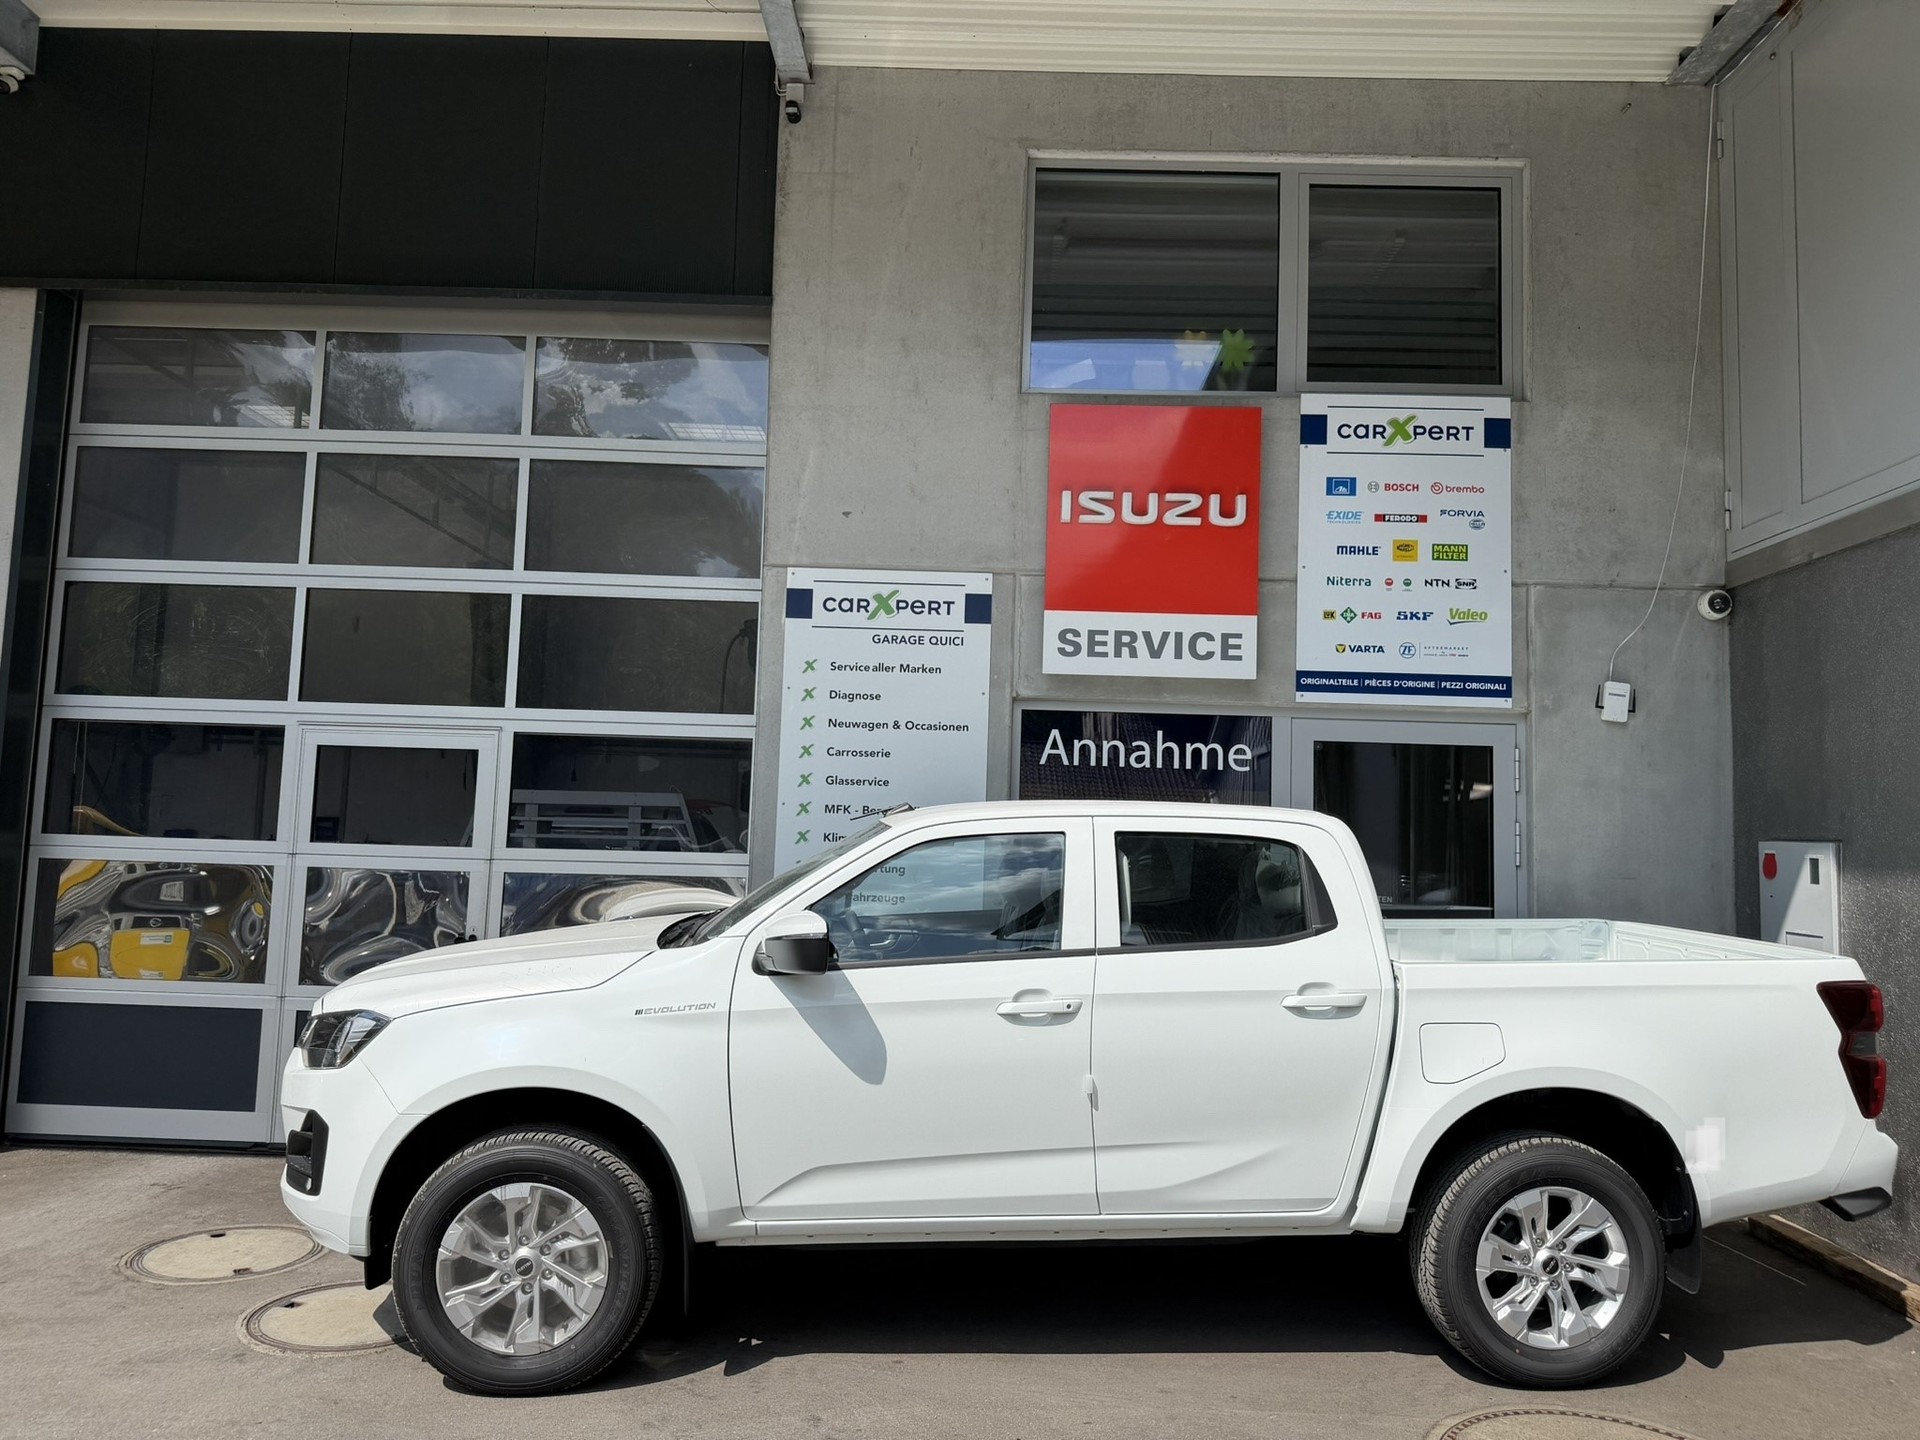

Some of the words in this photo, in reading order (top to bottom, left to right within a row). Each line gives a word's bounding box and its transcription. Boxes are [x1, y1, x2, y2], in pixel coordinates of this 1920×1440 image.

[1384, 483, 1419, 492] BOSCH
[1445, 485, 1485, 494] brembo
[1060, 490, 1247, 527] ISUZU
[1440, 509, 1485, 518] FORVIA
[1326, 511, 1362, 520] EXIDE
[1336, 545, 1379, 556] MAHLE
[1433, 545, 1466, 553] MANN
[1433, 552, 1466, 560] FILTER
[1326, 576, 1372, 587] Niterra
[1424, 578, 1450, 588] NTN
[1456, 580, 1475, 588] SNR
[1361, 611, 1382, 620] FAG
[1396, 611, 1434, 621] SKF
[1449, 608, 1488, 621] Valeo
[872, 634, 925, 646] GARAGE
[929, 635, 964, 647] QUICI
[1056, 628, 1244, 662] SERVICE
[1348, 645, 1385, 653] VARTA
[830, 661, 871, 673] Service
[871, 662, 896, 674] aller
[899, 663, 942, 674] Marken
[1300, 677, 1359, 686] ORIGINALTEILE
[1364, 677, 1392, 687] PIÈCES
[1393, 679, 1436, 688] D'ORIGINE
[1441, 680, 1464, 690] PEZZI
[1465, 682, 1507, 691] ORIGINALI
[829, 690, 882, 702] Diagnose
[828, 718, 889, 731] Neuwagen
[892, 720, 901, 730] &
[904, 720, 969, 732] Occasionen
[826, 747, 891, 758] Carrosserie
[1039, 728, 1252, 773] Annahme
[825, 775, 890, 787] Glasservice
[824, 804, 851, 815] MFK
[643, 1002, 717, 1015] EVOLUTION
